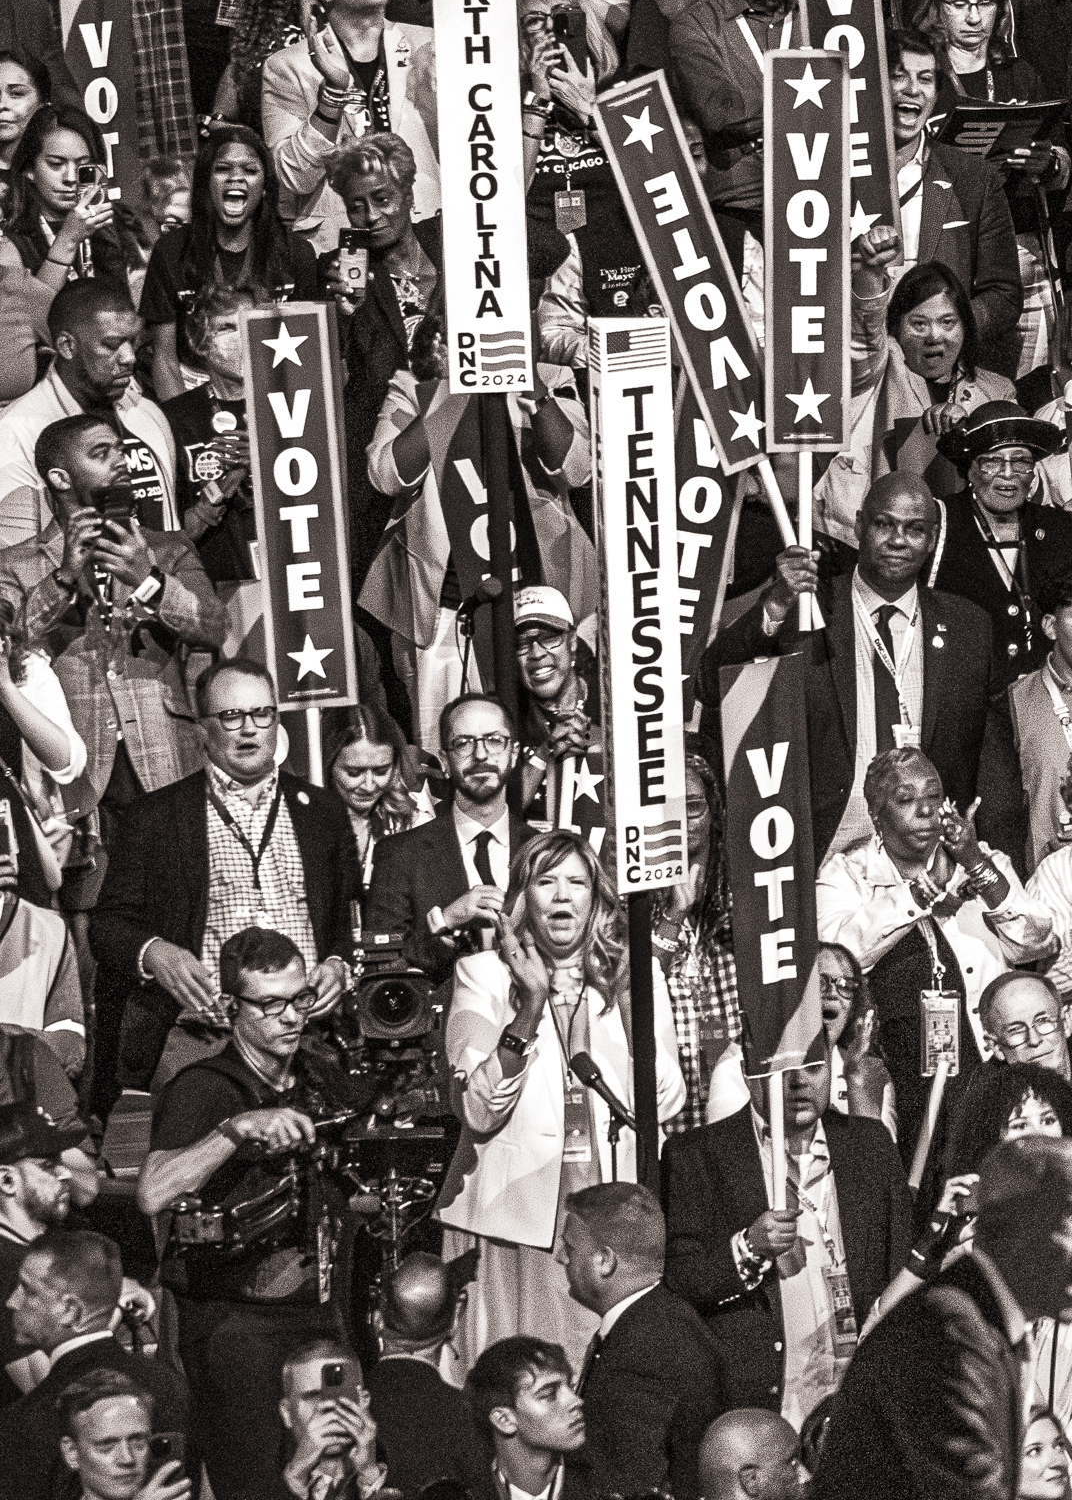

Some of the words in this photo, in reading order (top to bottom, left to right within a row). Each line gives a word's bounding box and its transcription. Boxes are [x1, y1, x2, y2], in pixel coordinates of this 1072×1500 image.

[468, 84, 503, 319] CAROLINA
[644, 171, 751, 388] VOTE
[786, 132, 830, 353] VOTE
[267, 389, 324, 611] VOTE
[622, 386, 666, 807] TENNESSEE
[745, 742, 796, 985] VOTE
